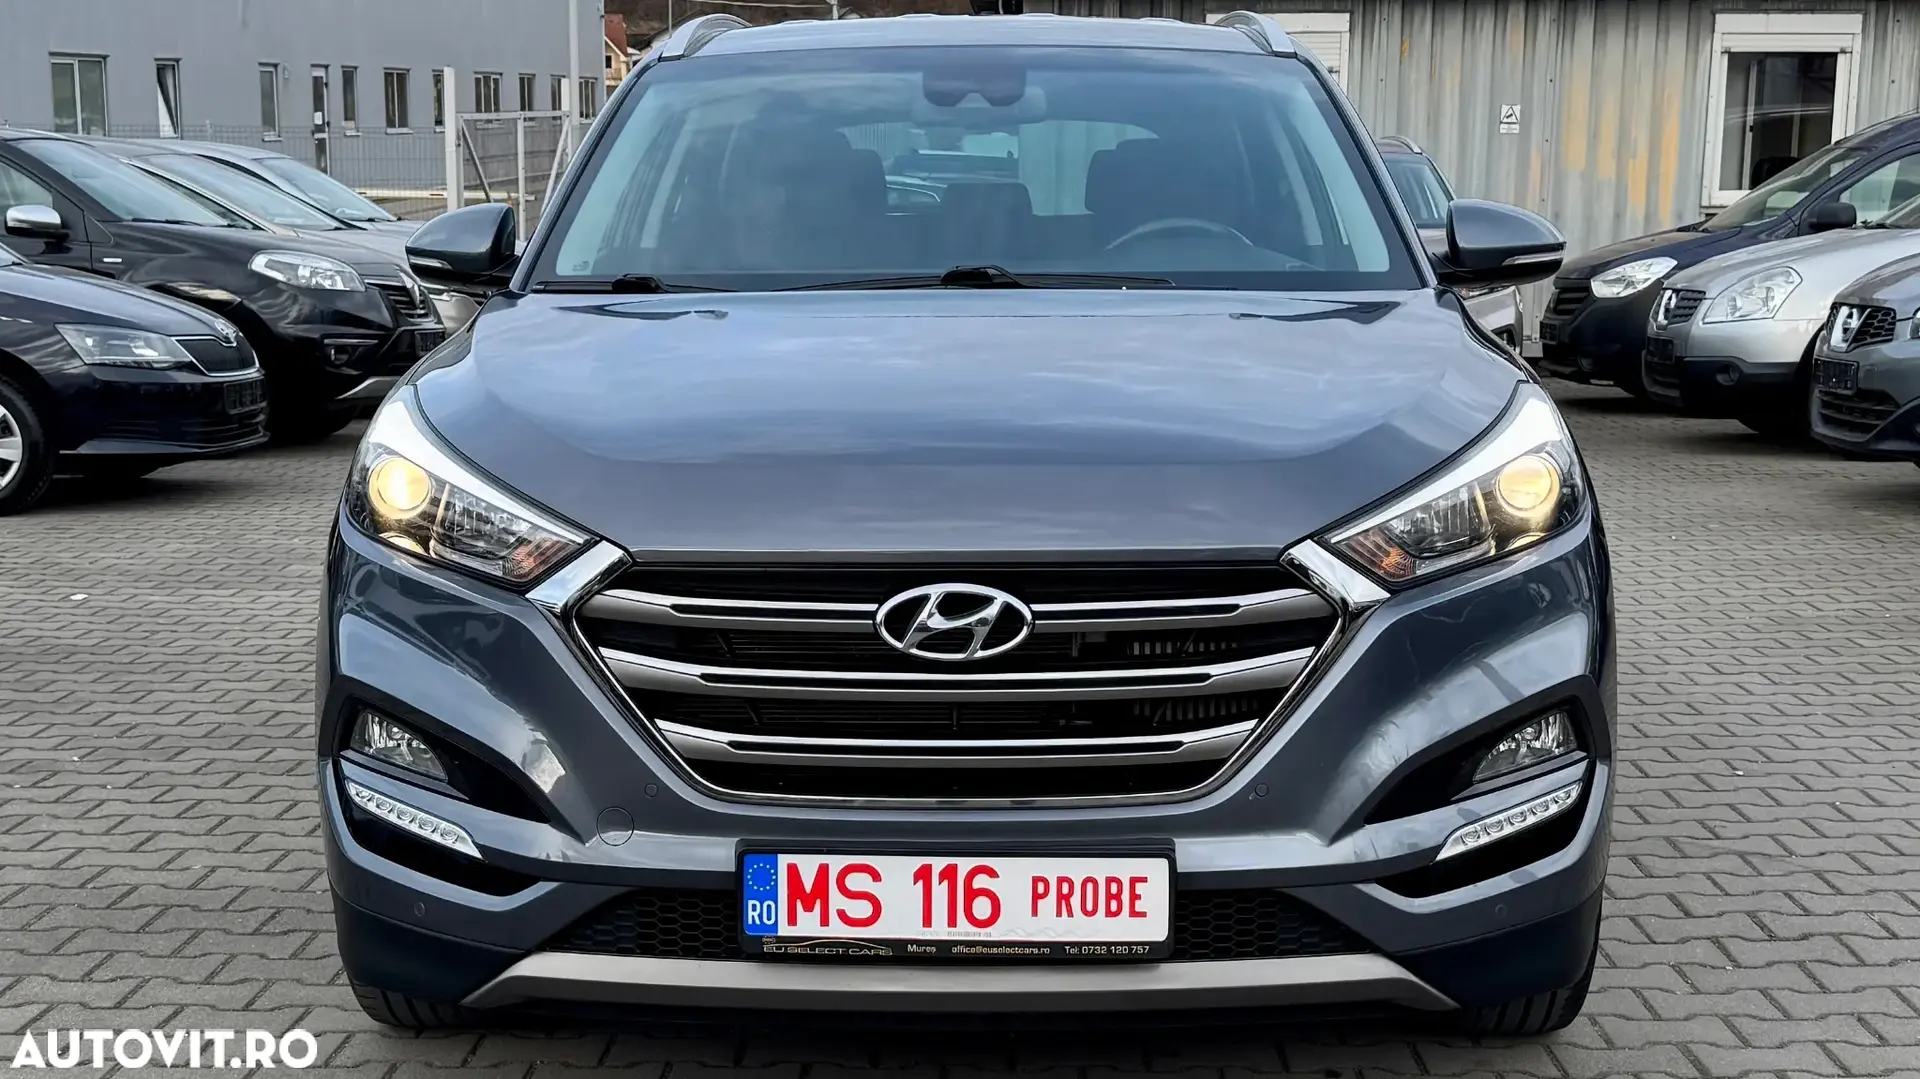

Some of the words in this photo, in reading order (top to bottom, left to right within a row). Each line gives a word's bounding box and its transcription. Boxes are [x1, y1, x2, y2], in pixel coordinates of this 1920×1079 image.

[786, 863, 882, 927] MS
[913, 863, 1001, 929] 116
[1031, 876, 1148, 918] PROBE
[747, 900, 776, 925] RO
[787, 946, 846, 954] SELECT
[849, 948, 893, 956] CARS
[951, 945, 1050, 955] office@euselectcars.ro
[1064, 945, 1080, 954] Tel:
[1082, 945, 1107, 954] 0732
[1110, 945, 1129, 954] 120
[1131, 945, 1150, 954] 757
